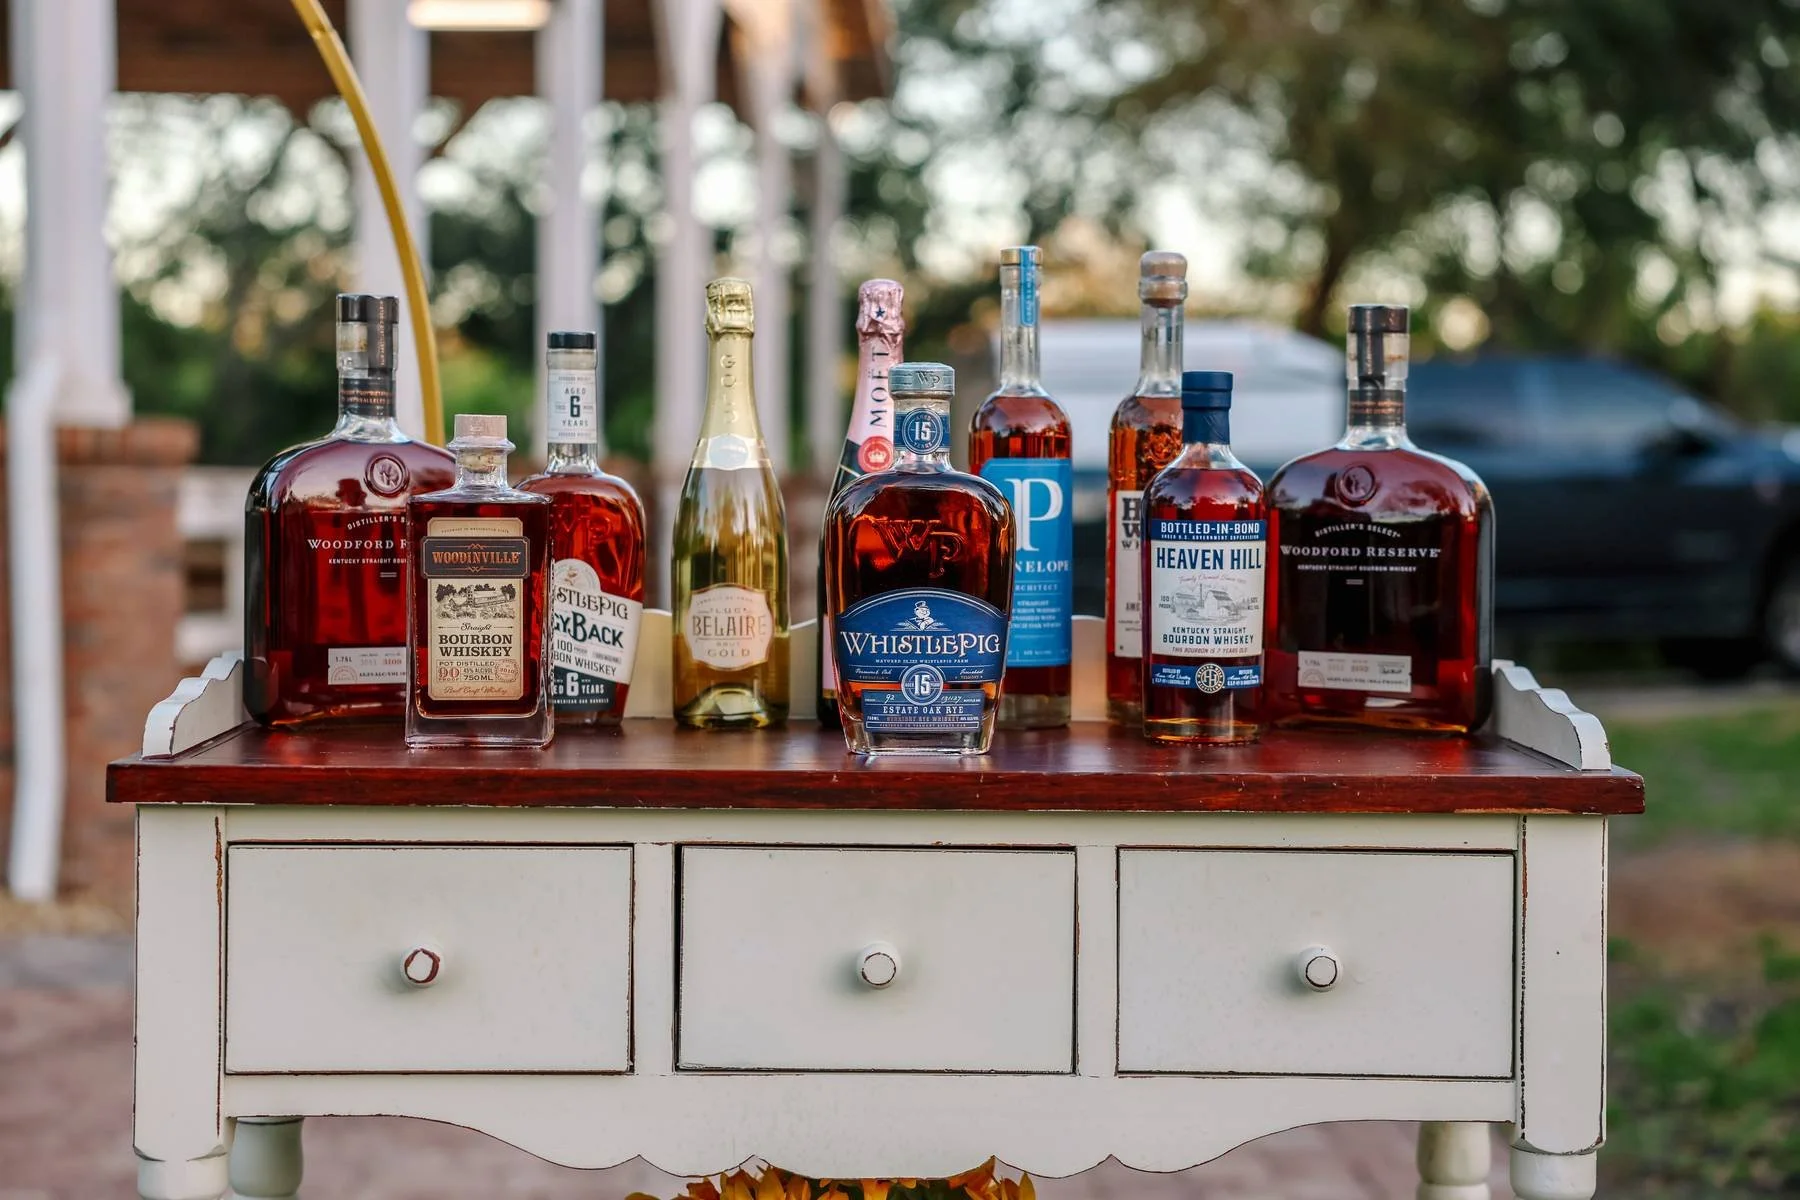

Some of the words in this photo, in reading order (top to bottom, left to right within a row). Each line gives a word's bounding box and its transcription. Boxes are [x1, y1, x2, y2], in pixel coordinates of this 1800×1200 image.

[570, 395, 581, 418] 6
[914, 421, 932, 441] 15
[1160, 522, 1260, 534] BOTTLED-IN-BOND
[1314, 523, 1364, 538] DISTILLER'S
[1367, 524, 1398, 538] SELECT
[307, 539, 394, 550] WOODFORD
[1280, 544, 1361, 557] WOODFORD
[1366, 546, 1440, 558] RESERVE
[432, 551, 520, 564] WOODINVILLE
[1156, 547, 1224, 570] HEAVEN
[1230, 548, 1262, 570] HILL
[460, 622, 493, 632] Straight
[692, 615, 767, 638] BELAIRE
[1172, 626, 1210, 634] KENTUCKY
[1213, 626, 1246, 634] STRAIGHT
[438, 634, 513, 645] BOURBON
[840, 630, 1001, 658] WHISTLEPIG
[1162, 634, 1210, 644] BOURBON
[1214, 635, 1254, 644] WHISKEY
[438, 646, 513, 657] WHISKEY
[557, 639, 573, 653] 100
[707, 648, 751, 657] GOLD
[438, 667, 461, 678] 90
[574, 656, 617, 677] WHISKEY
[566, 672, 580, 697] 6
[581, 684, 605, 695] YEARS
[914, 674, 931, 697] 15
[883, 706, 920, 714] ESTATE
[922, 706, 942, 714] OAK
[946, 706, 964, 714] RYE
